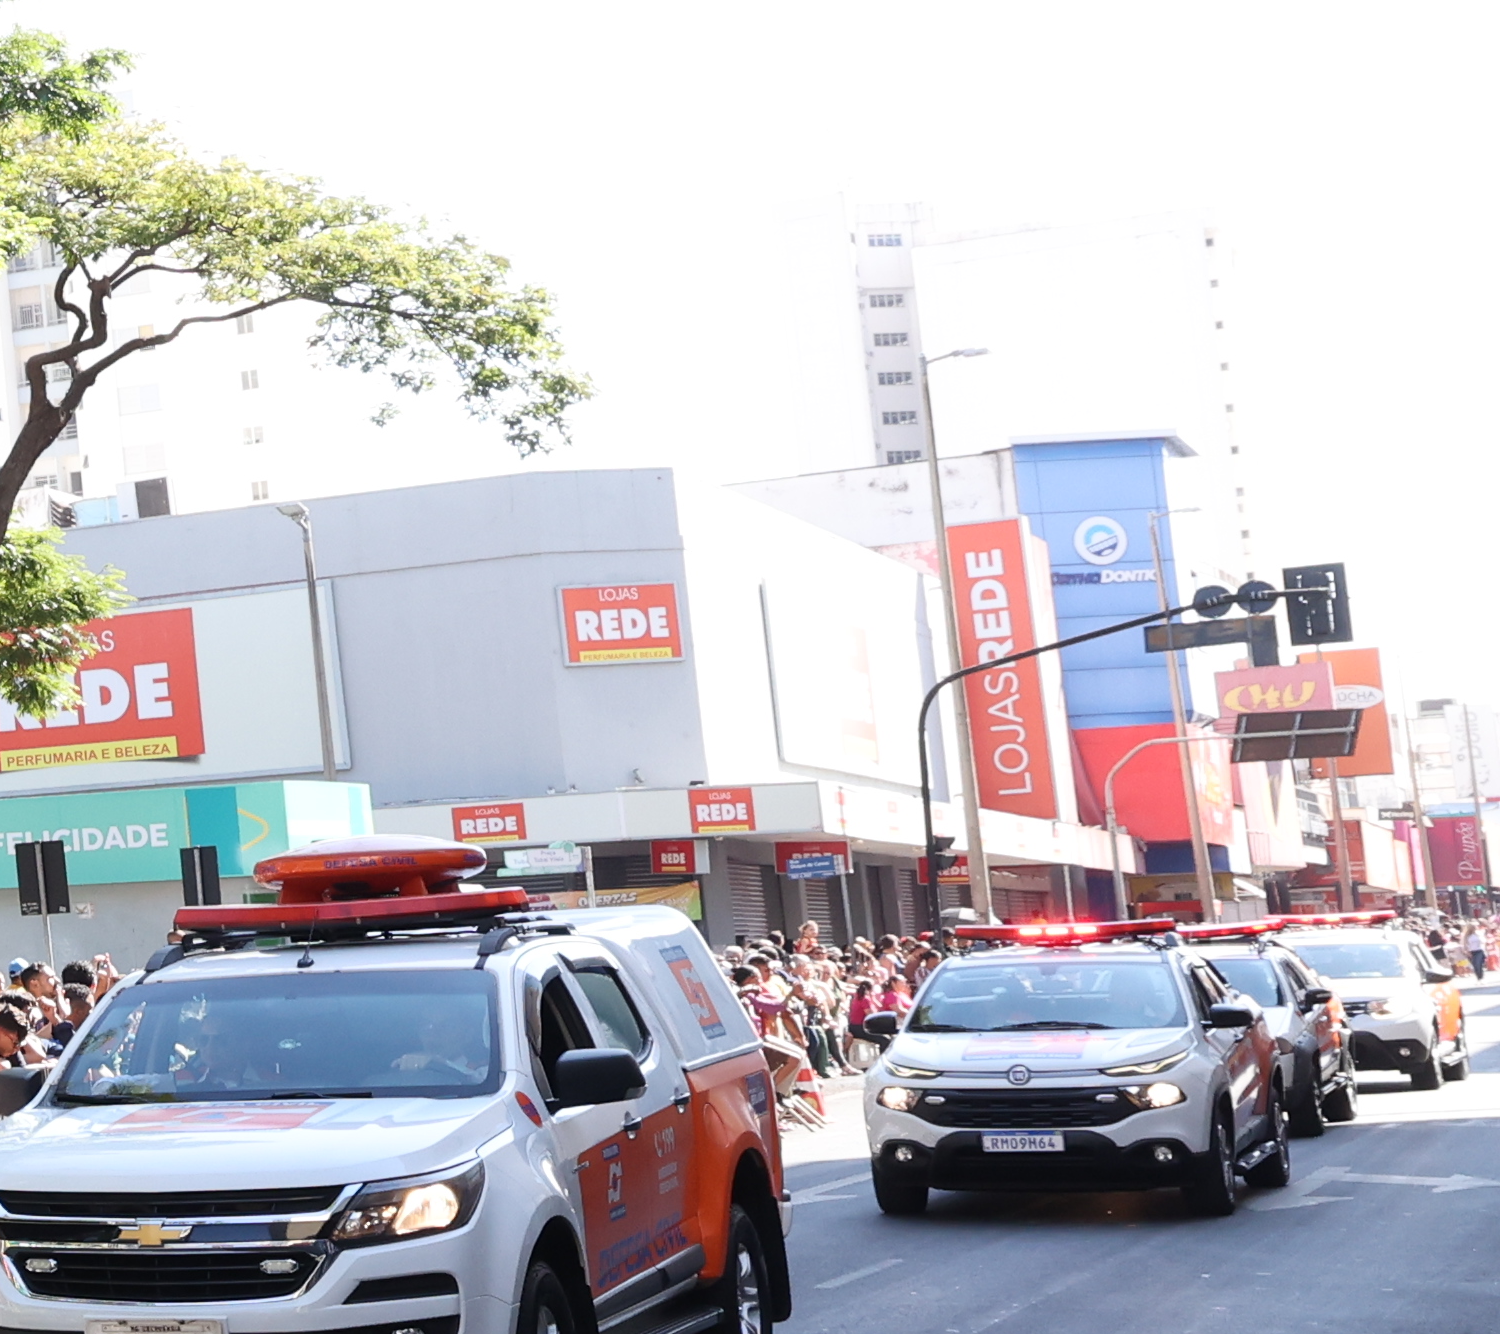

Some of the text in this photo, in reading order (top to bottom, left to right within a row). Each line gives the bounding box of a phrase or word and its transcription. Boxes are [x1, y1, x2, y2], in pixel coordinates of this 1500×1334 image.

[598, 587, 639, 601] LOJAS
[575, 606, 669, 642] REDE
[7, 744, 171, 767] PERFUMARIA E BELEZA
[696, 802, 748, 822] REDE
[460, 816, 518, 834] REDE
[323, 859, 376, 870] DEFESA
[661, 852, 686, 864] REDE
